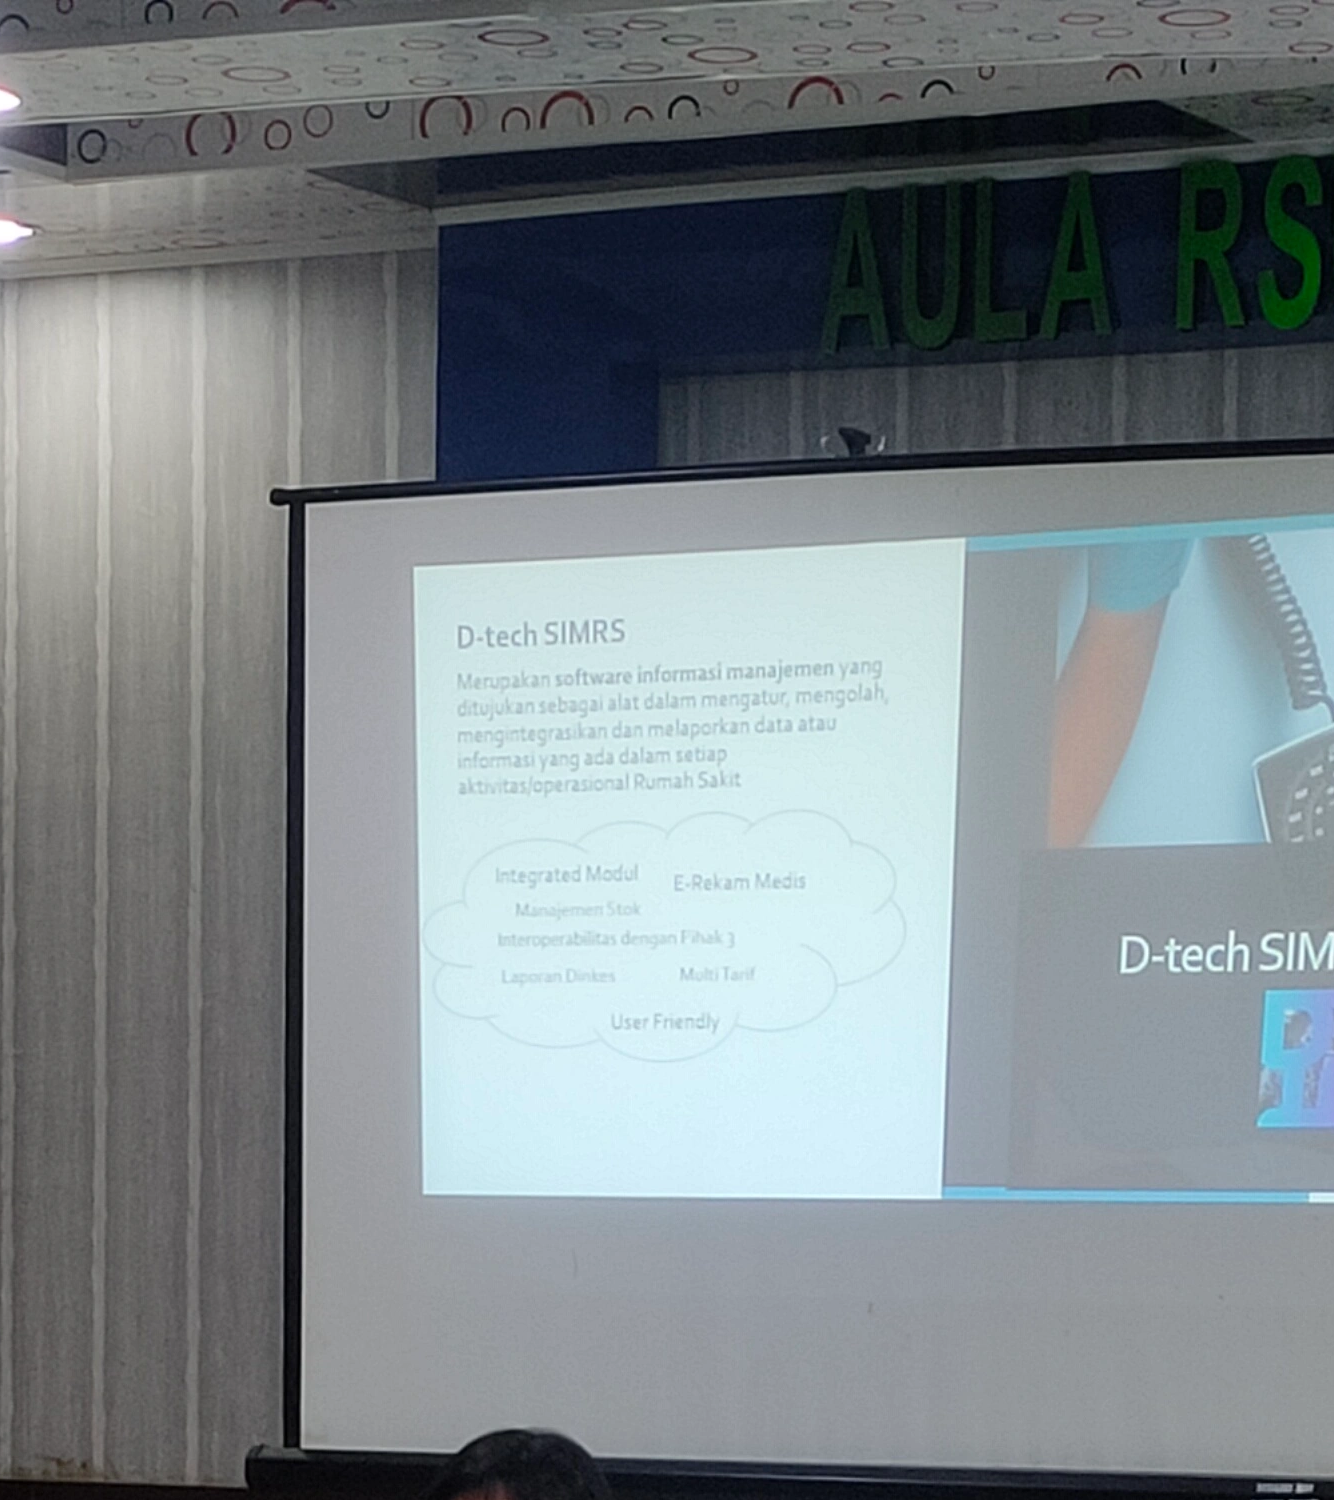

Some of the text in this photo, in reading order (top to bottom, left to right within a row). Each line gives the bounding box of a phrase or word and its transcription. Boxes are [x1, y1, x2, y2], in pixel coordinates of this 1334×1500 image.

[821, 170, 1114, 355] AULA
[457, 618, 625, 650] D-tech SIMRS
[457, 658, 883, 694] Merupakan software informasi manajemen yang
[457, 682, 889, 722] ditujukan sebagai alat dalam mengatur, mengolah,
[457, 715, 837, 749] mengintegrasikan dan melaporkan data atau
[457, 746, 727, 773] informasi yang ada dalam setiap
[458, 770, 742, 798] aktivitas/operasional Rumah Sakit
[495, 864, 639, 889] Integrated Modul
[674, 872, 807, 892] E-Rekam Medis
[515, 901, 641, 921] Manajemen Stok
[620, 930, 677, 950] dengan
[1119, 930, 1250, 975] D-tech
[501, 968, 616, 986] Laporan Dinkes
[680, 965, 756, 982] Multi Tarif
[611, 1012, 720, 1034] User Friendly
